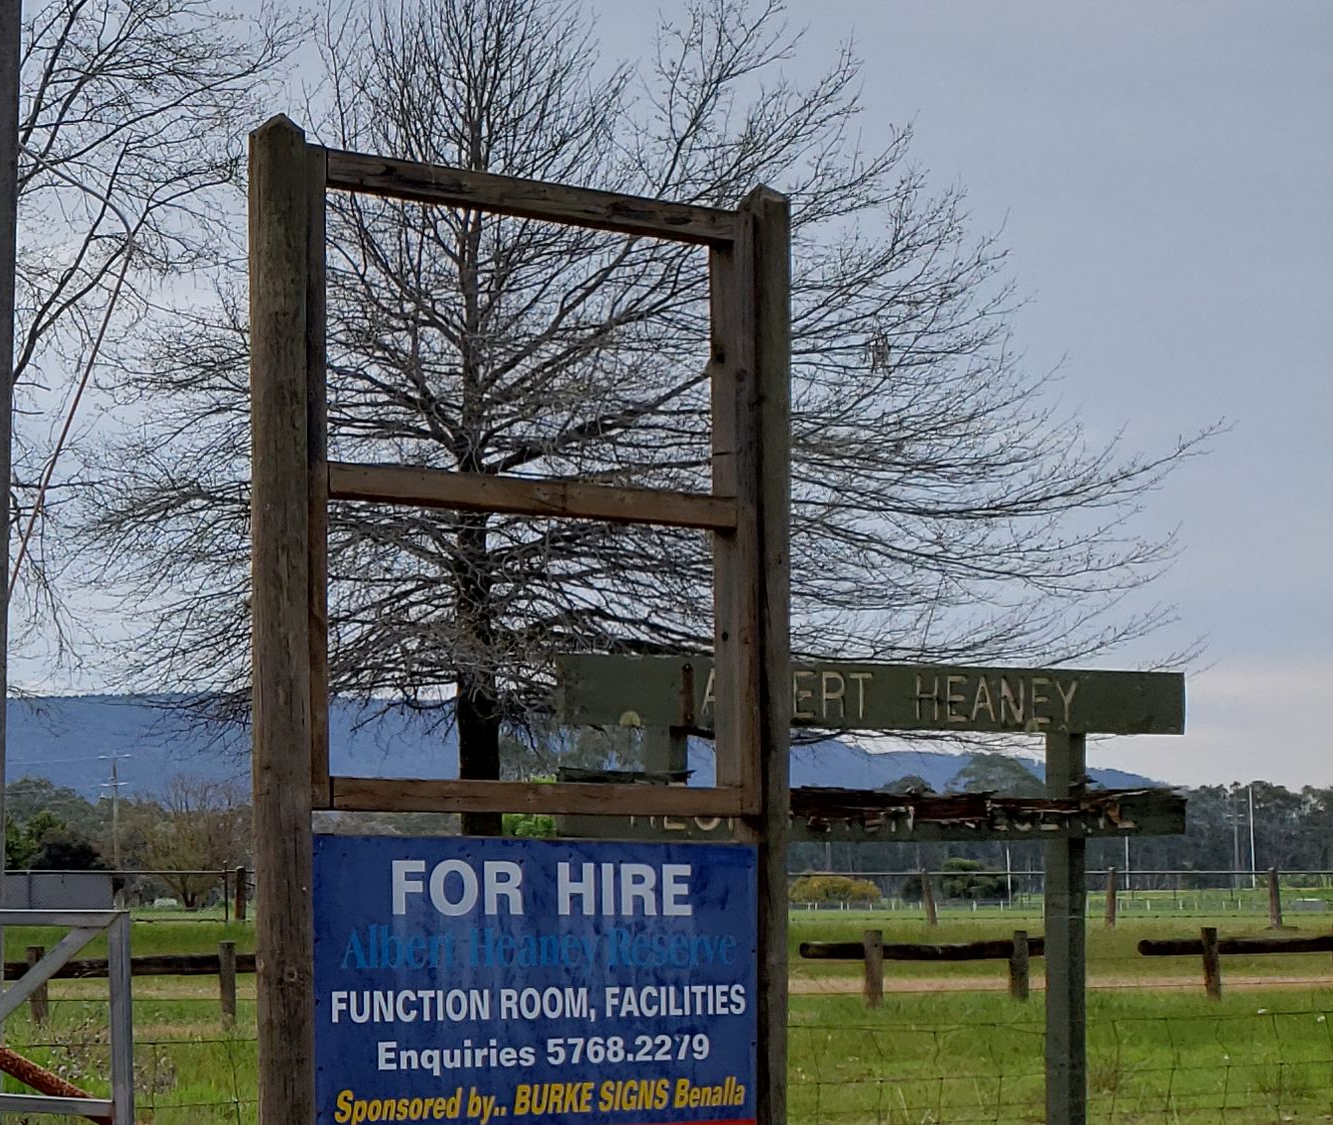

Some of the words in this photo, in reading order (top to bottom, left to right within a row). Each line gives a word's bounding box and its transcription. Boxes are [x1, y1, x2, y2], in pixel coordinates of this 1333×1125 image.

[701, 668, 872, 719] AERT
[915, 674, 1079, 725] HEANEY
[391, 859, 524, 917] FOR
[557, 861, 693, 917] HIRE
[339, 924, 455, 970] Albert
[469, 928, 599, 976] Heaney
[607, 928, 737, 968] Reserve
[331, 989, 490, 1024] FUNCTION
[500, 986, 597, 1022] ROOM,
[605, 984, 746, 1018] FACILITIES
[377, 1038, 536, 1077] Enquiries
[546, 1033, 711, 1066] 5768.2279
[514, 1081, 595, 1117] BURKE
[598, 1078, 669, 1112] SIGNS
[673, 1076, 746, 1109] Benalla
